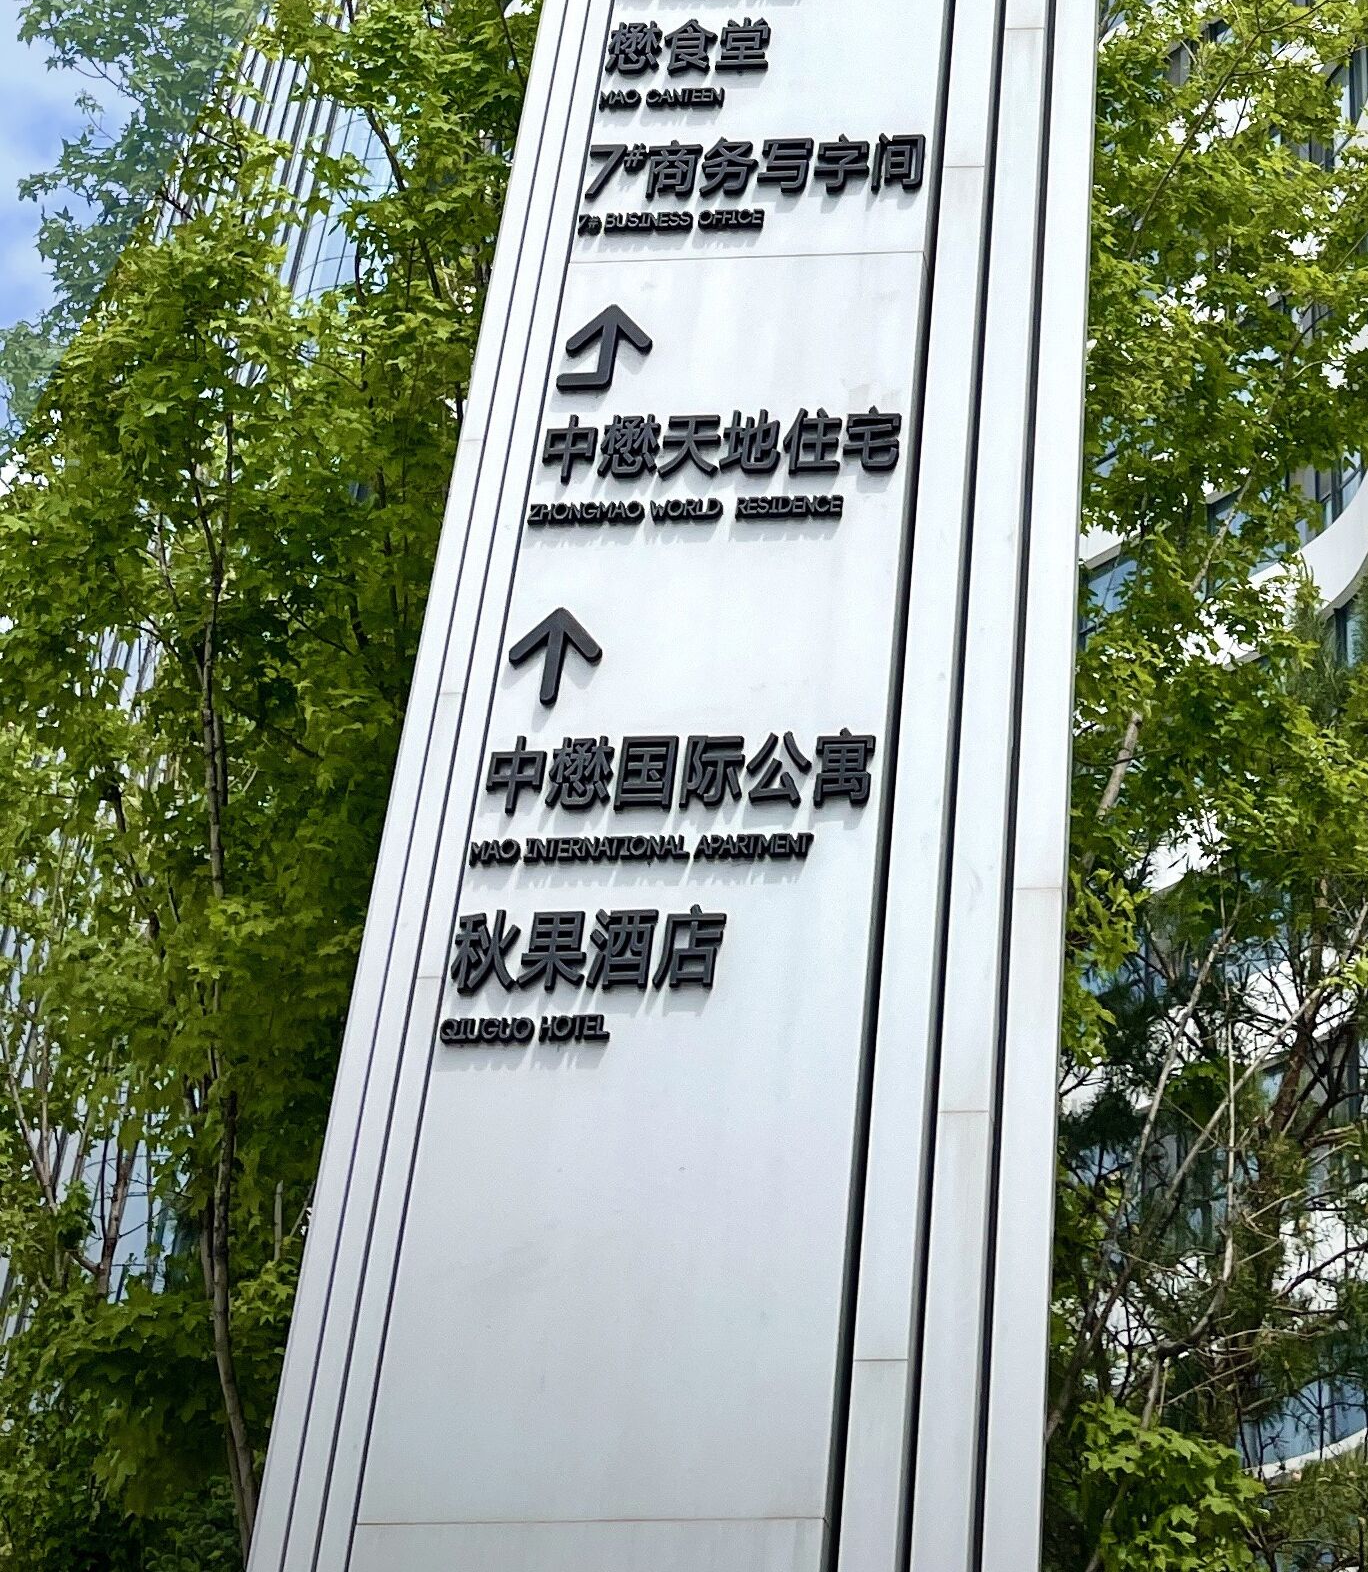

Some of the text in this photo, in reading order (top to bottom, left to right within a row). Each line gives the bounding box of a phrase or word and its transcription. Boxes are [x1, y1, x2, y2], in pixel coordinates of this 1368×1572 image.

[604, 17, 771, 75] 懋食堂
[599, 87, 725, 112] MAO CANTEEN
[585, 133, 926, 202] 7#商务写字间
[578, 209, 765, 236] 7# BUSINESS OFFICE
[542, 405, 902, 485] 中懋天地住宅
[527, 494, 844, 526] ZHONGMAO WORLD RESIDENCE
[485, 727, 876, 815] 中懋国际公寓
[469, 832, 814, 867] MAO INTERNATIONAL APARTMENT
[451, 904, 727, 995] 秋果酒店
[440, 1014, 610, 1044] QIUGUO HOTEL
